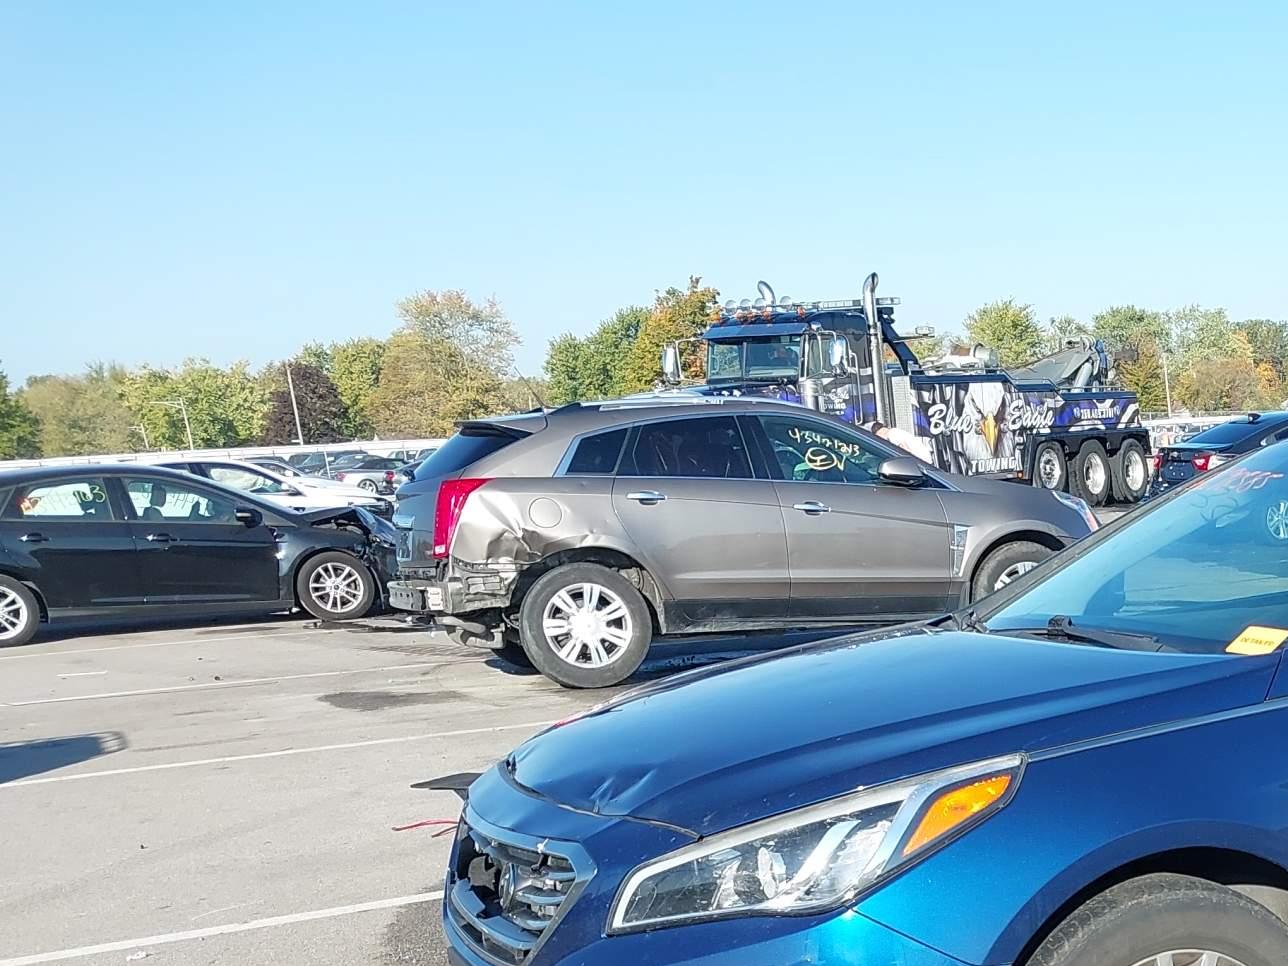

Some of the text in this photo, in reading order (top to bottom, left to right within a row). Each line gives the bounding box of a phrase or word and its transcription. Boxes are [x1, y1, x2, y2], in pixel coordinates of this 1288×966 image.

[927, 399, 1054, 435] Blue Eagle
[970, 458, 1017, 473] TOWING
